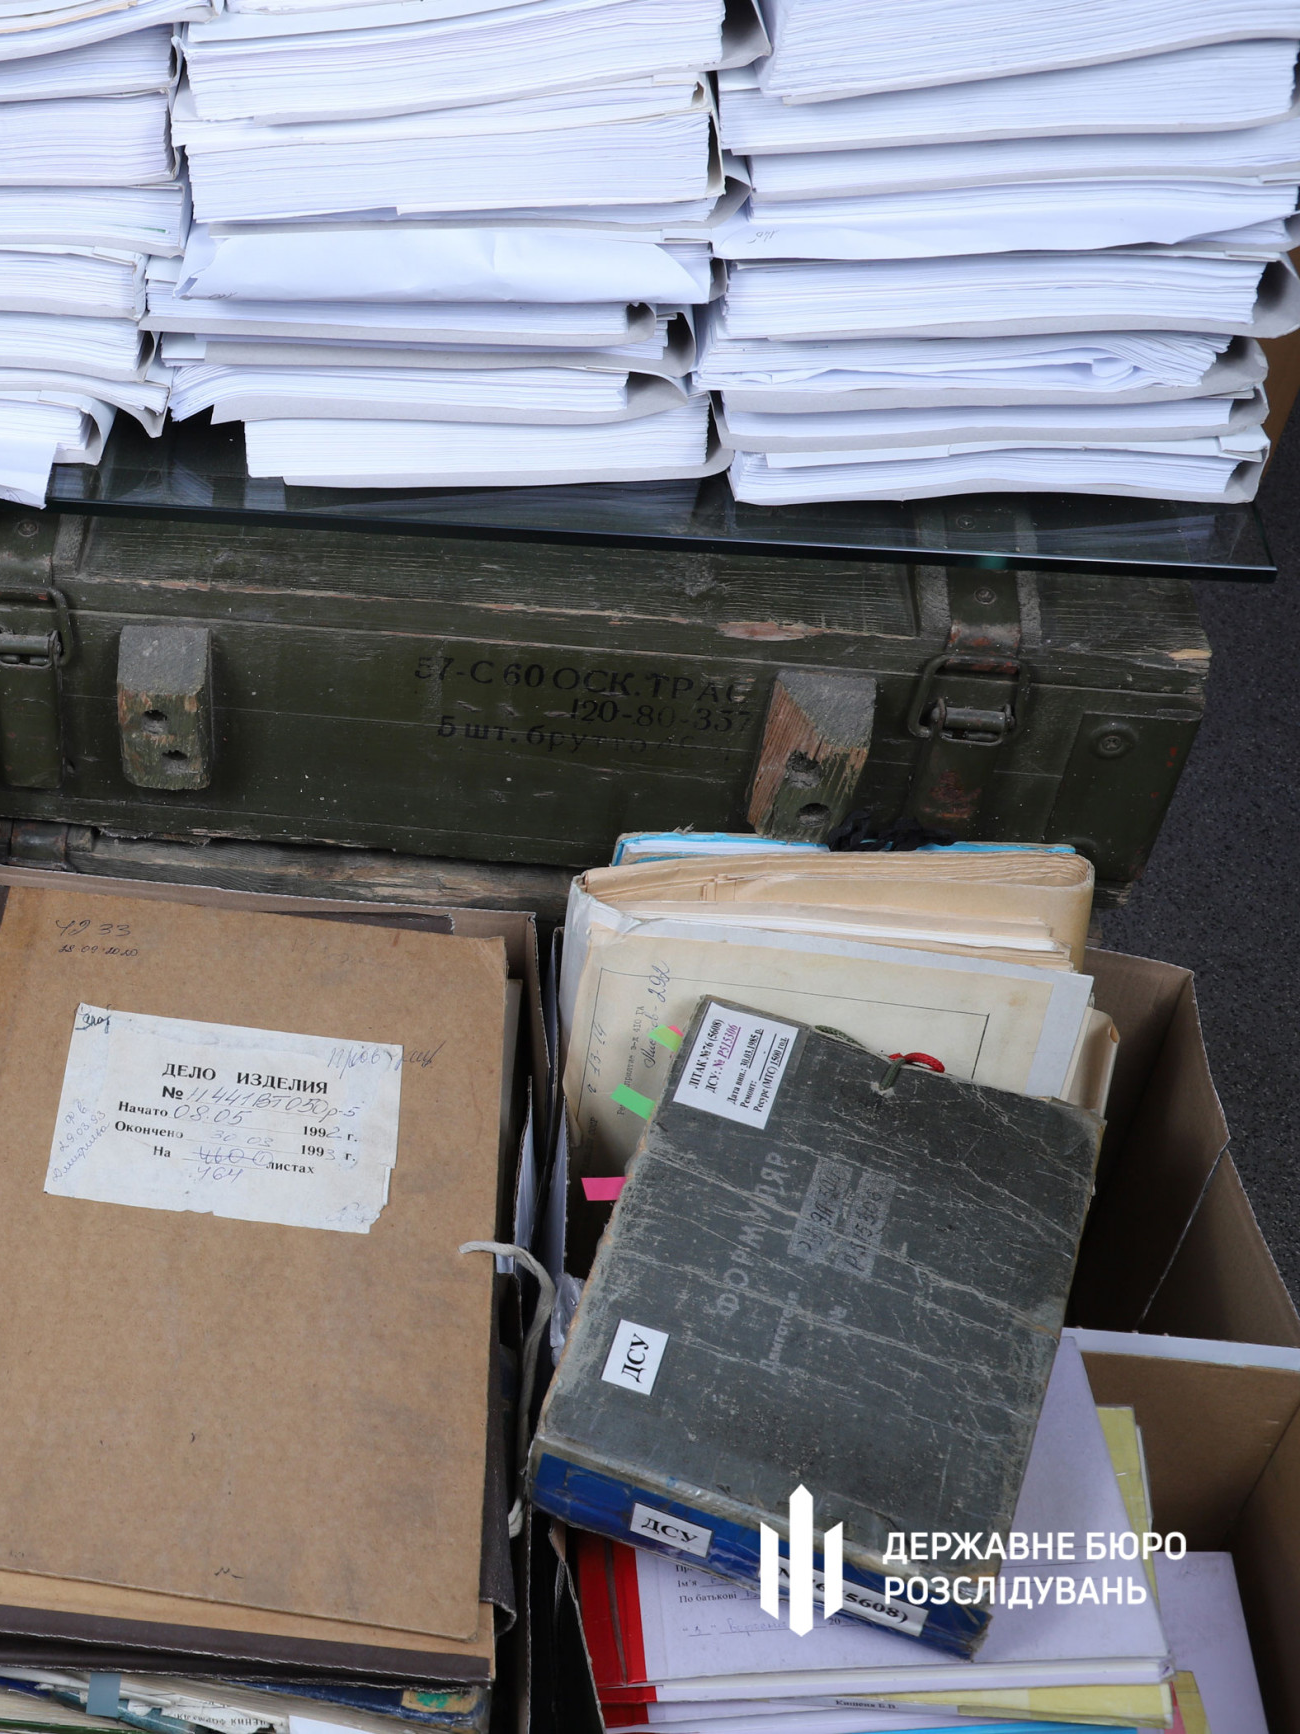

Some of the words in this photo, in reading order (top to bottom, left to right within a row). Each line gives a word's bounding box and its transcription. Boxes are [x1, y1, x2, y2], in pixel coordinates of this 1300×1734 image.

[688, 1059, 707, 1089] ЛІТАК
[707, 1019, 725, 1042] (5608)
[162, 1063, 217, 1081] ДЕЛО
[237, 1072, 329, 1095] ИЗДЕЛИЯ
[162, 1085, 184, 1101] №
[726, 1087, 738, 1105] Дата
[118, 1100, 169, 1118] Начато
[114, 1120, 184, 1140] Окончено
[153, 1145, 171, 1159] На
[266, 1162, 315, 1175] листах
[621, 1333, 649, 1384] ДСУ
[641, 1517, 698, 1543] ДСУ
[679, 1595, 693, 1603] По
[696, 1591, 737, 1602] батькові
[842, 1589, 908, 1623] 5608)
[829, 1618, 841, 1626] 20
